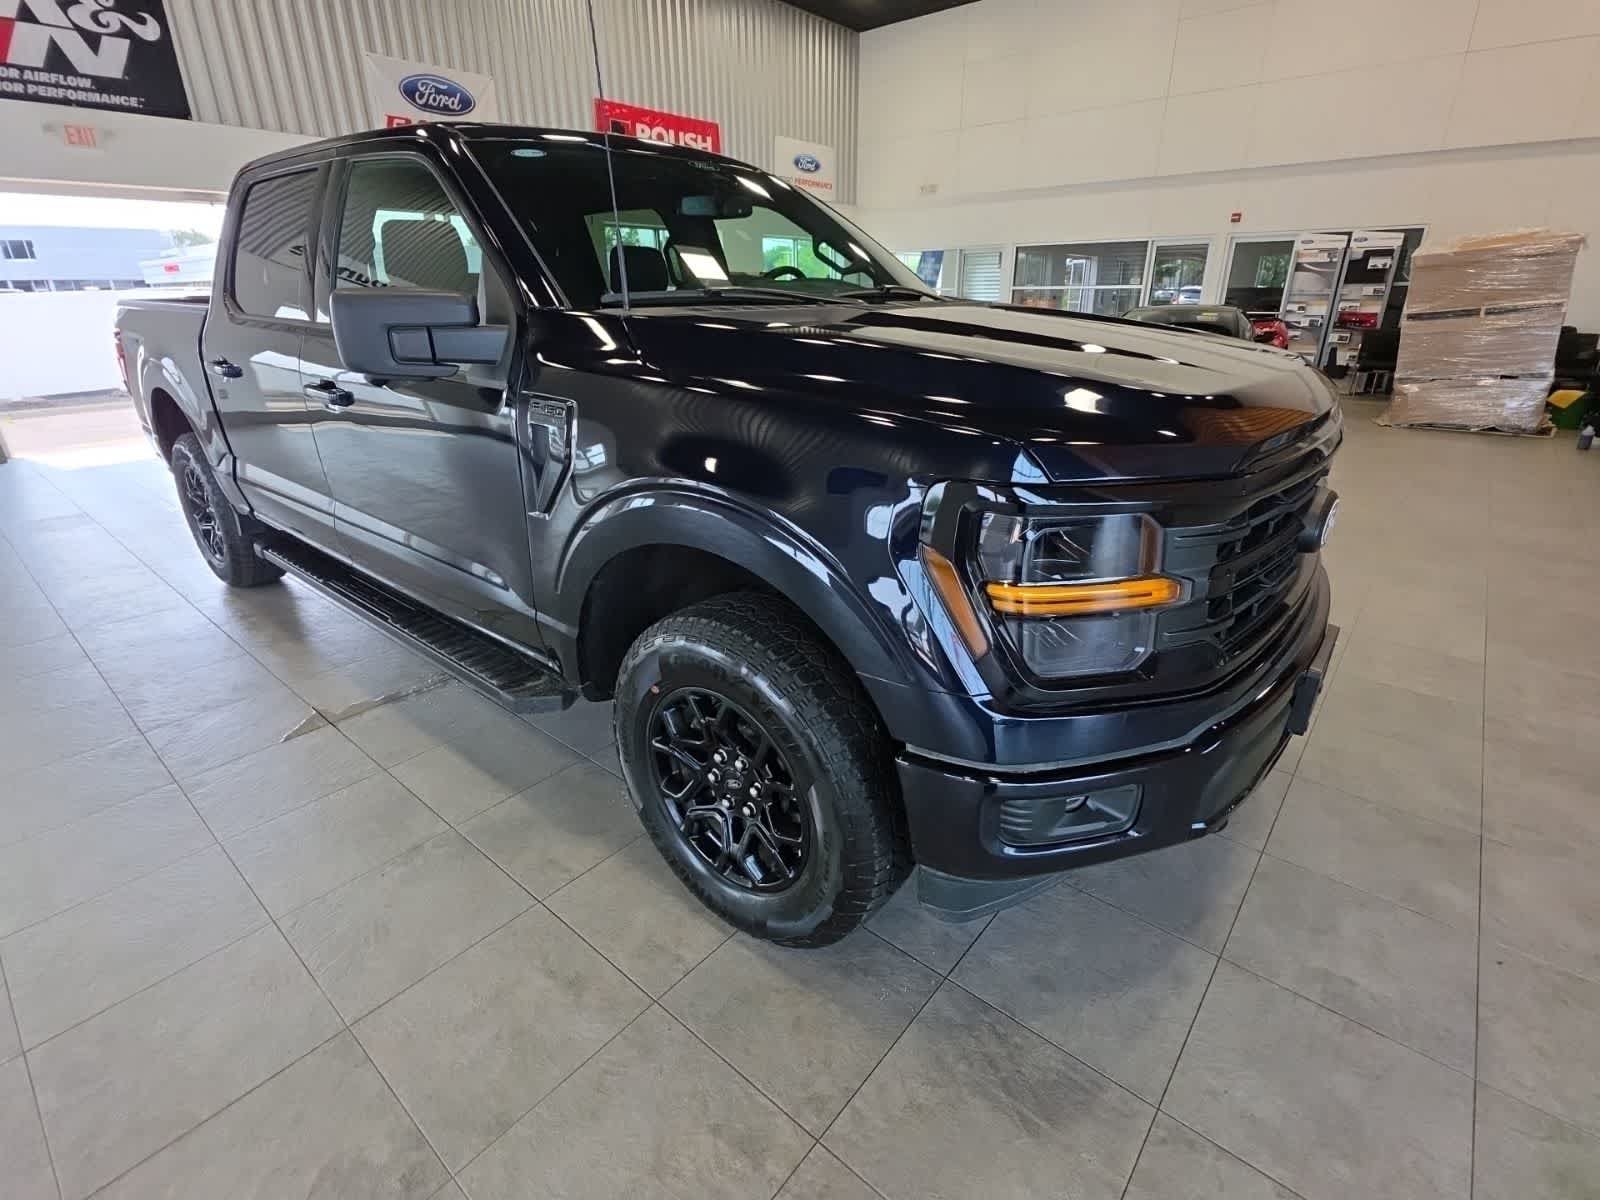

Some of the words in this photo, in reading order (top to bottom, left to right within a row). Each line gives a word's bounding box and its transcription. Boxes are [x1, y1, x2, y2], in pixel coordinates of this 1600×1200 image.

[23, 69, 96, 90] AIRFLOW.
[415, 79, 463, 111] Ford
[65, 125, 96, 147] EXIT
[798, 158, 817, 170] Ford
